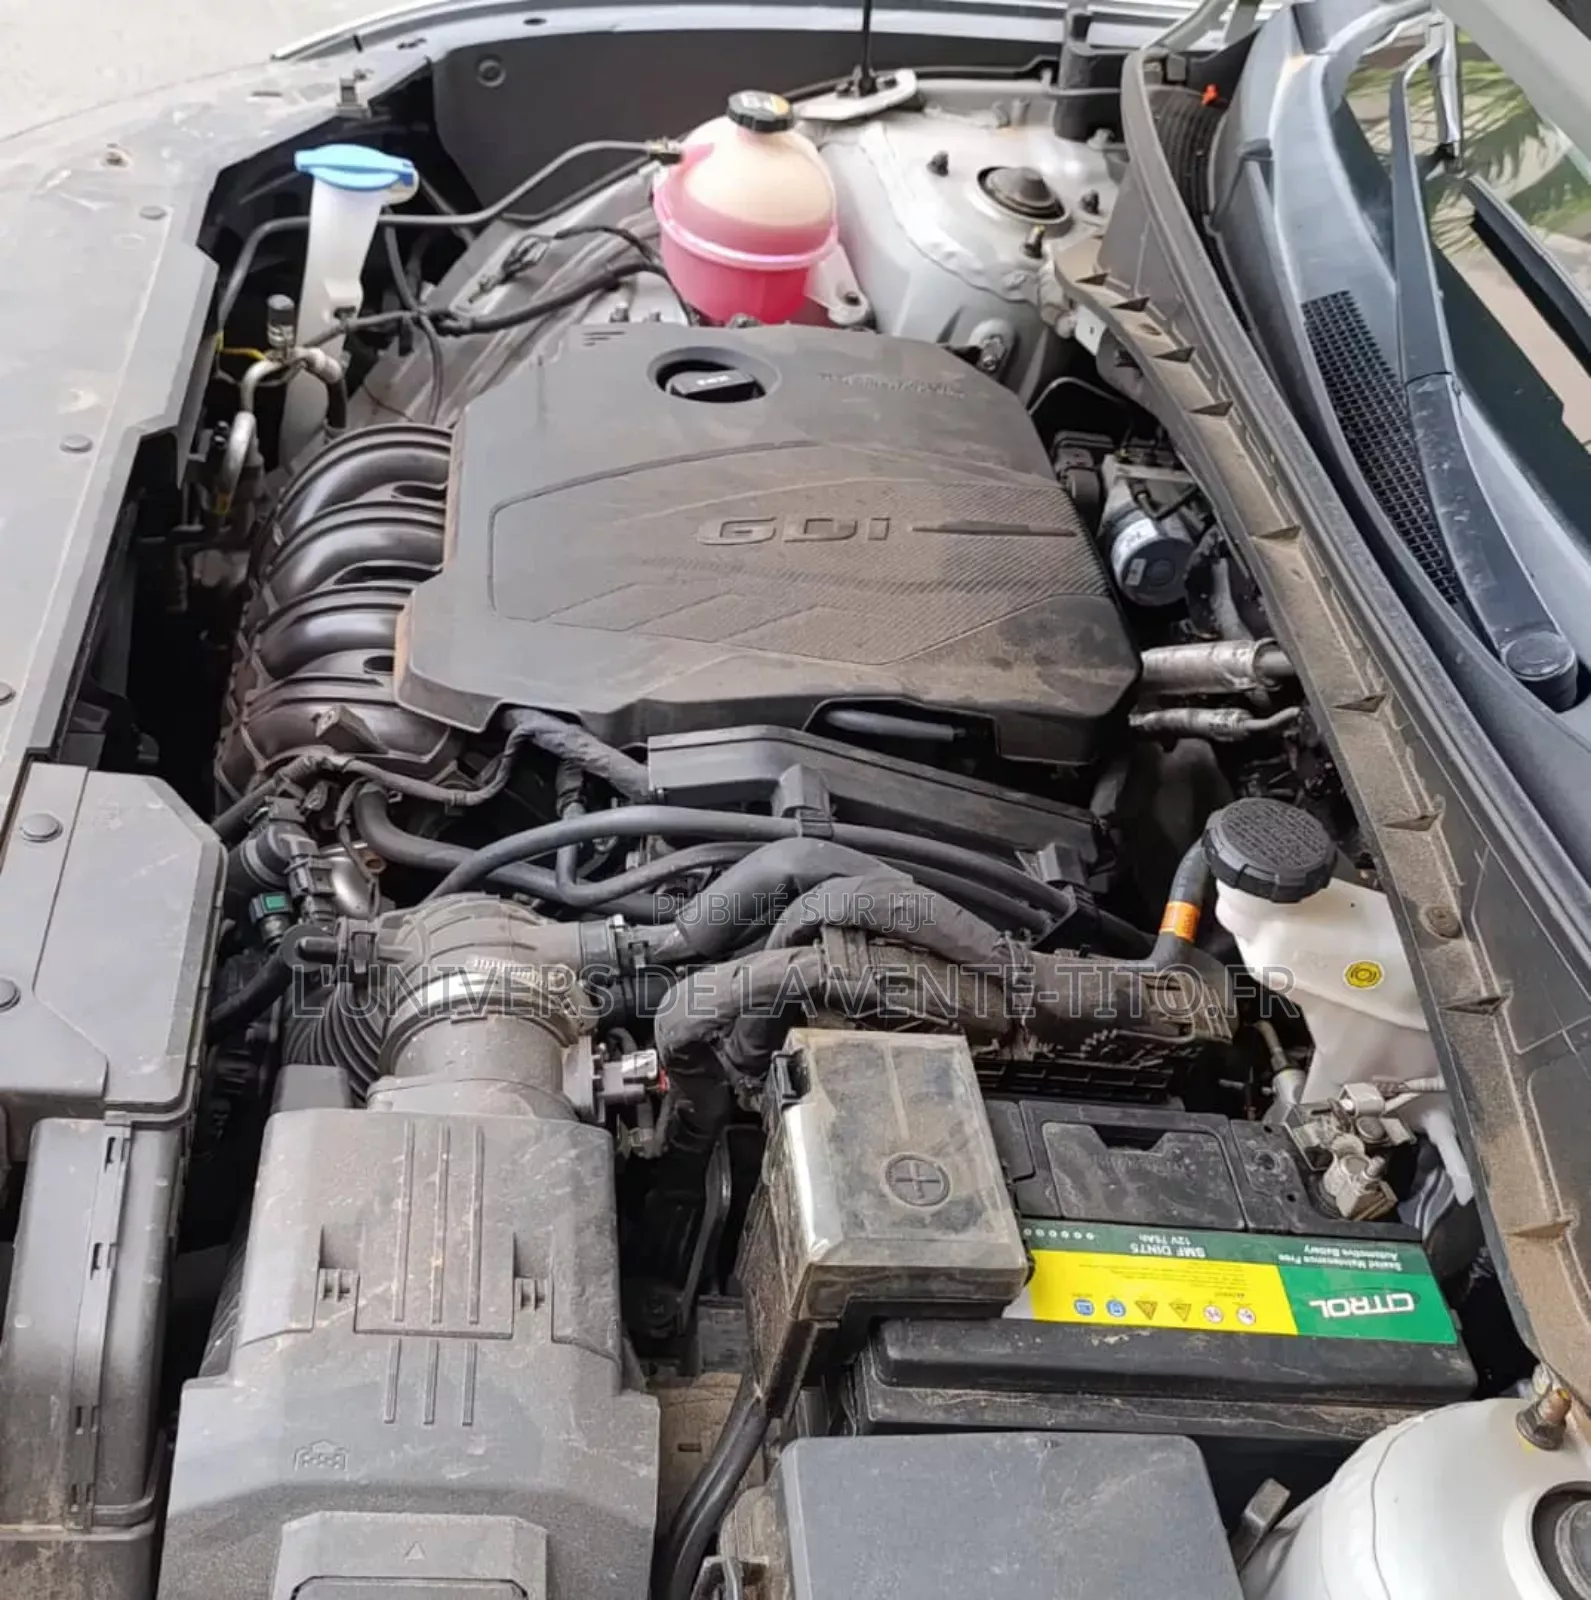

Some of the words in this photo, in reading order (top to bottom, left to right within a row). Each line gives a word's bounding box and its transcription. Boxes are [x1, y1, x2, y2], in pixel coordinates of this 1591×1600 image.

[1304, 1244, 1340, 1257] Battery
[1341, 1248, 1398, 1262] Automotive
[1277, 1253, 1302, 1265] Free
[1303, 1255, 1367, 1269] Maintenance
[1368, 1259, 1403, 1272] Sealed
[1308, 1292, 1416, 1319] CITROL
